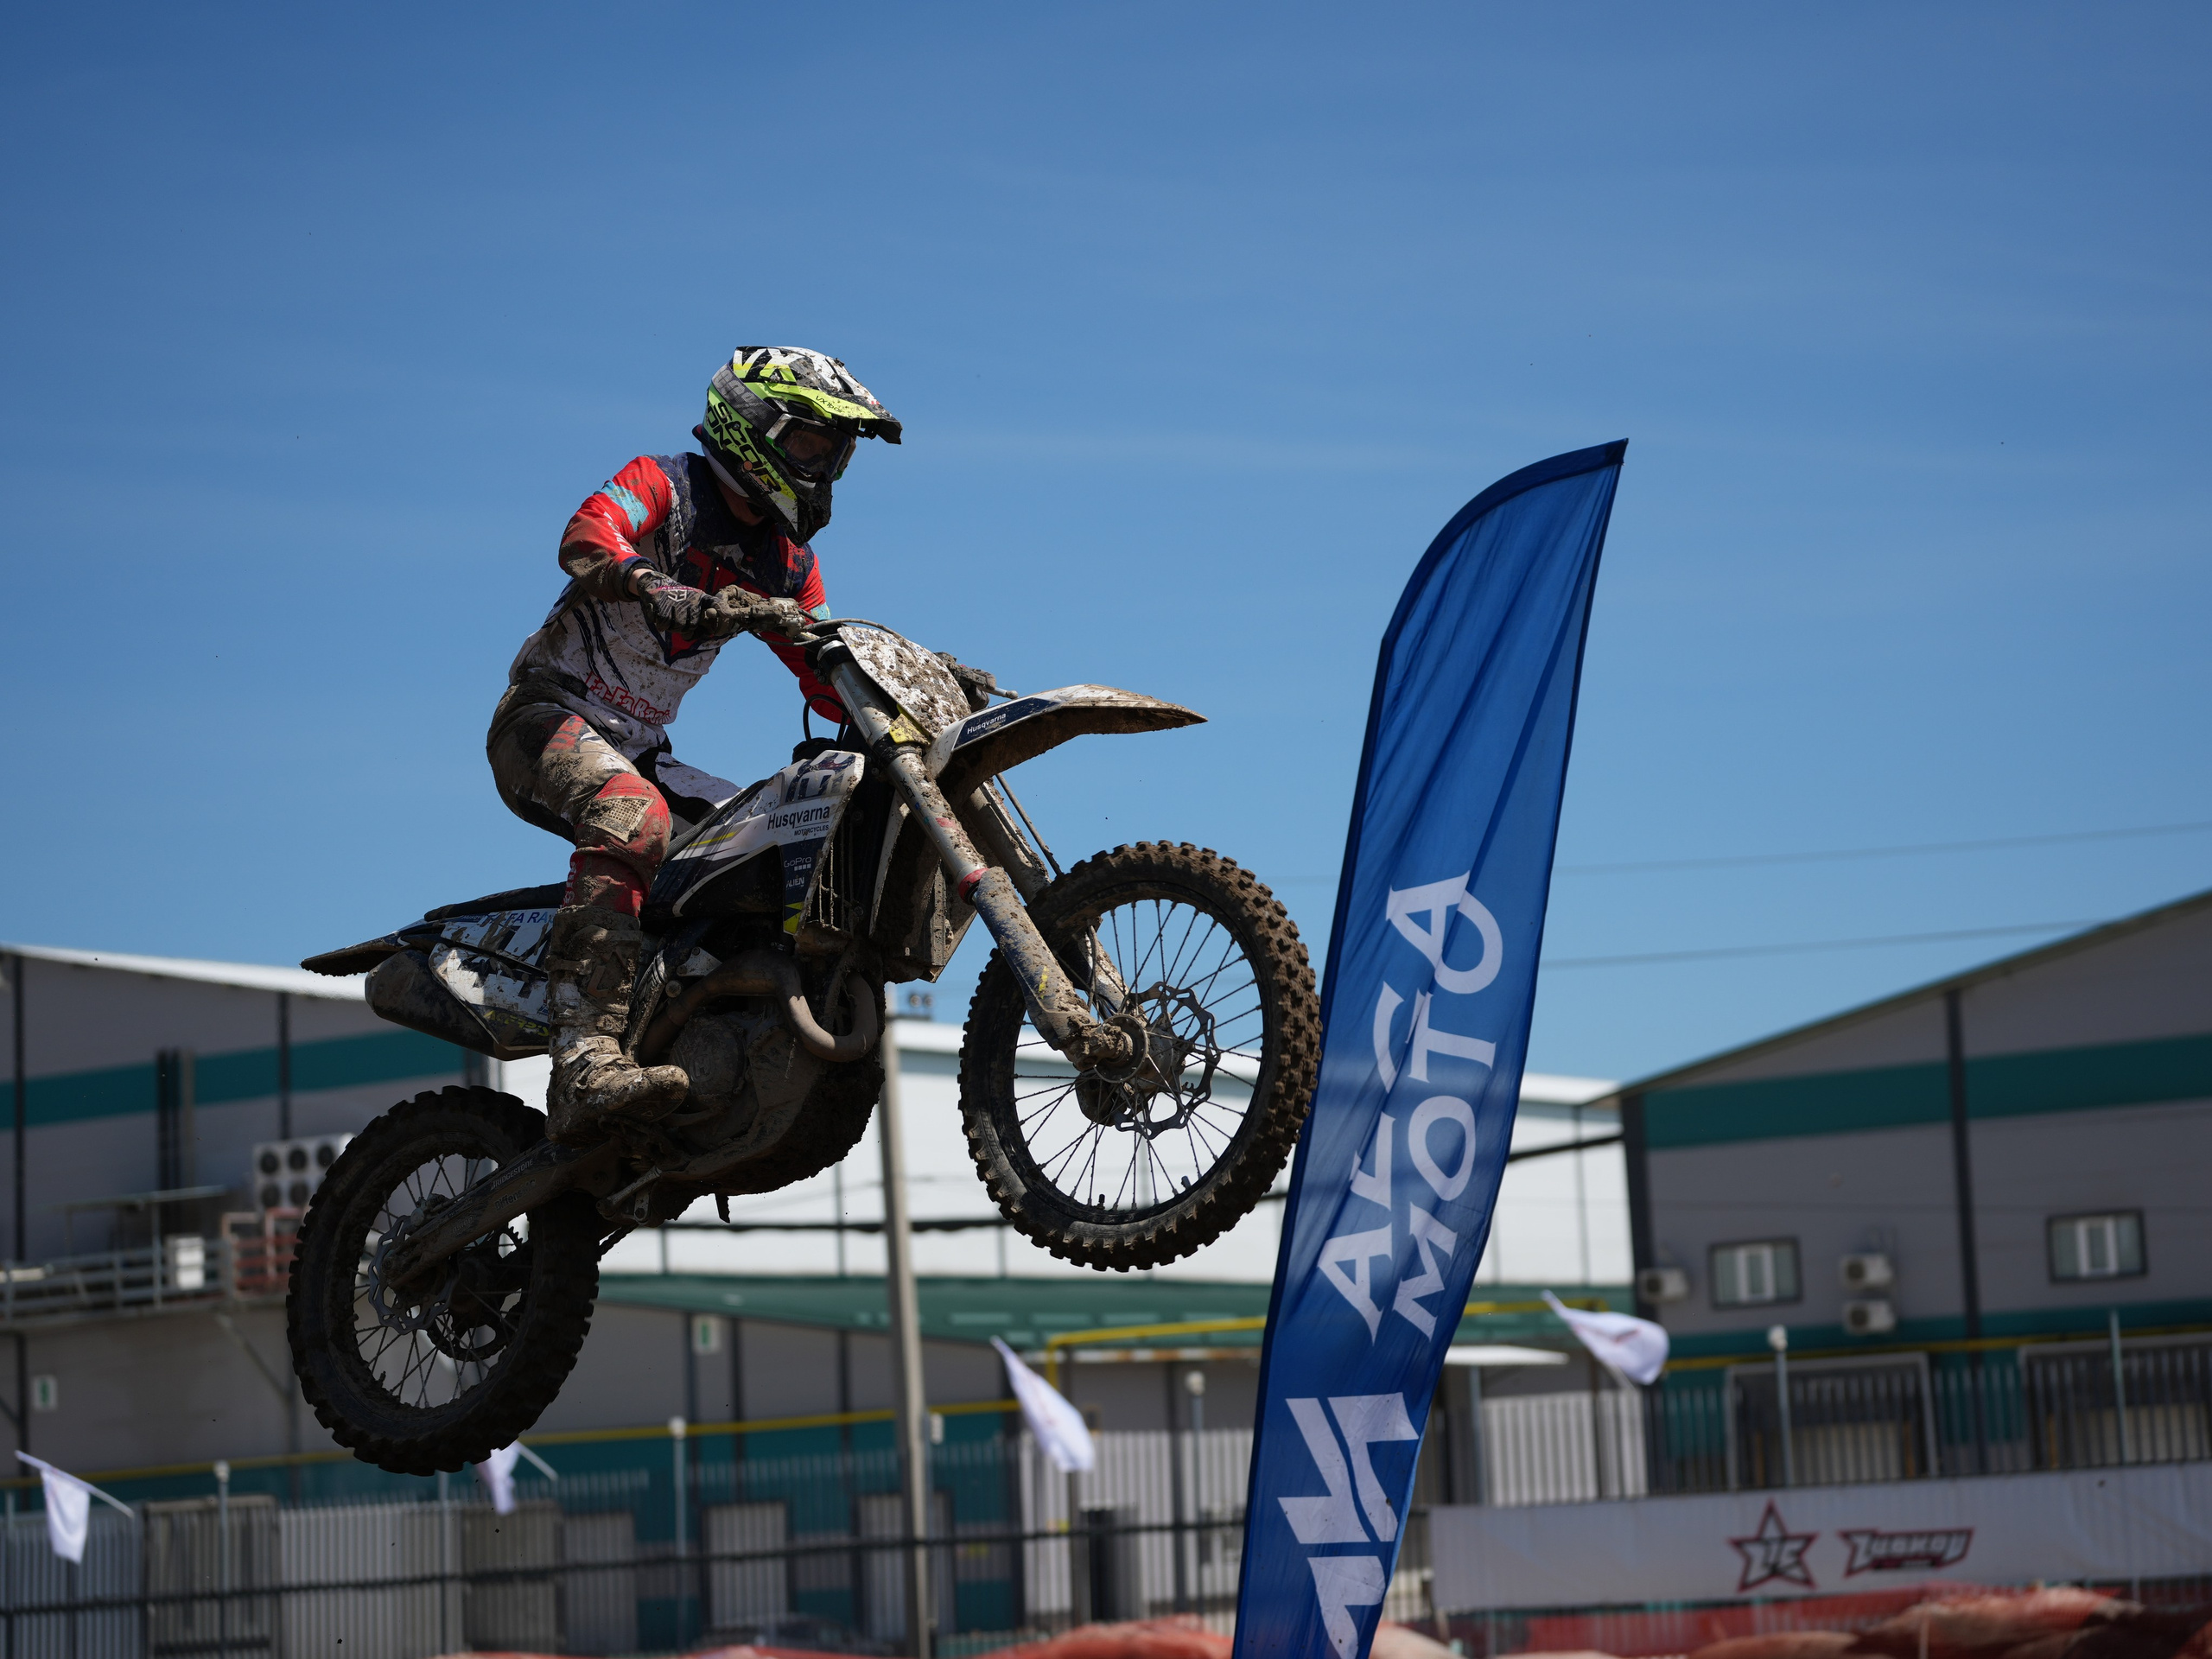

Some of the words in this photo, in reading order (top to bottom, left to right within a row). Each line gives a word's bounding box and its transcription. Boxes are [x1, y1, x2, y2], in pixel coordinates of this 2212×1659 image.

[967, 713, 1007, 734] Husqvarna
[766, 805, 830, 830] Husqvarna
[794, 824, 830, 836] MOTORCYCLES
[784, 856, 812, 868] GoPro
[1393, 888, 1503, 1342] MOTO
[490, 1159, 534, 1190] BRIDGESTONE
